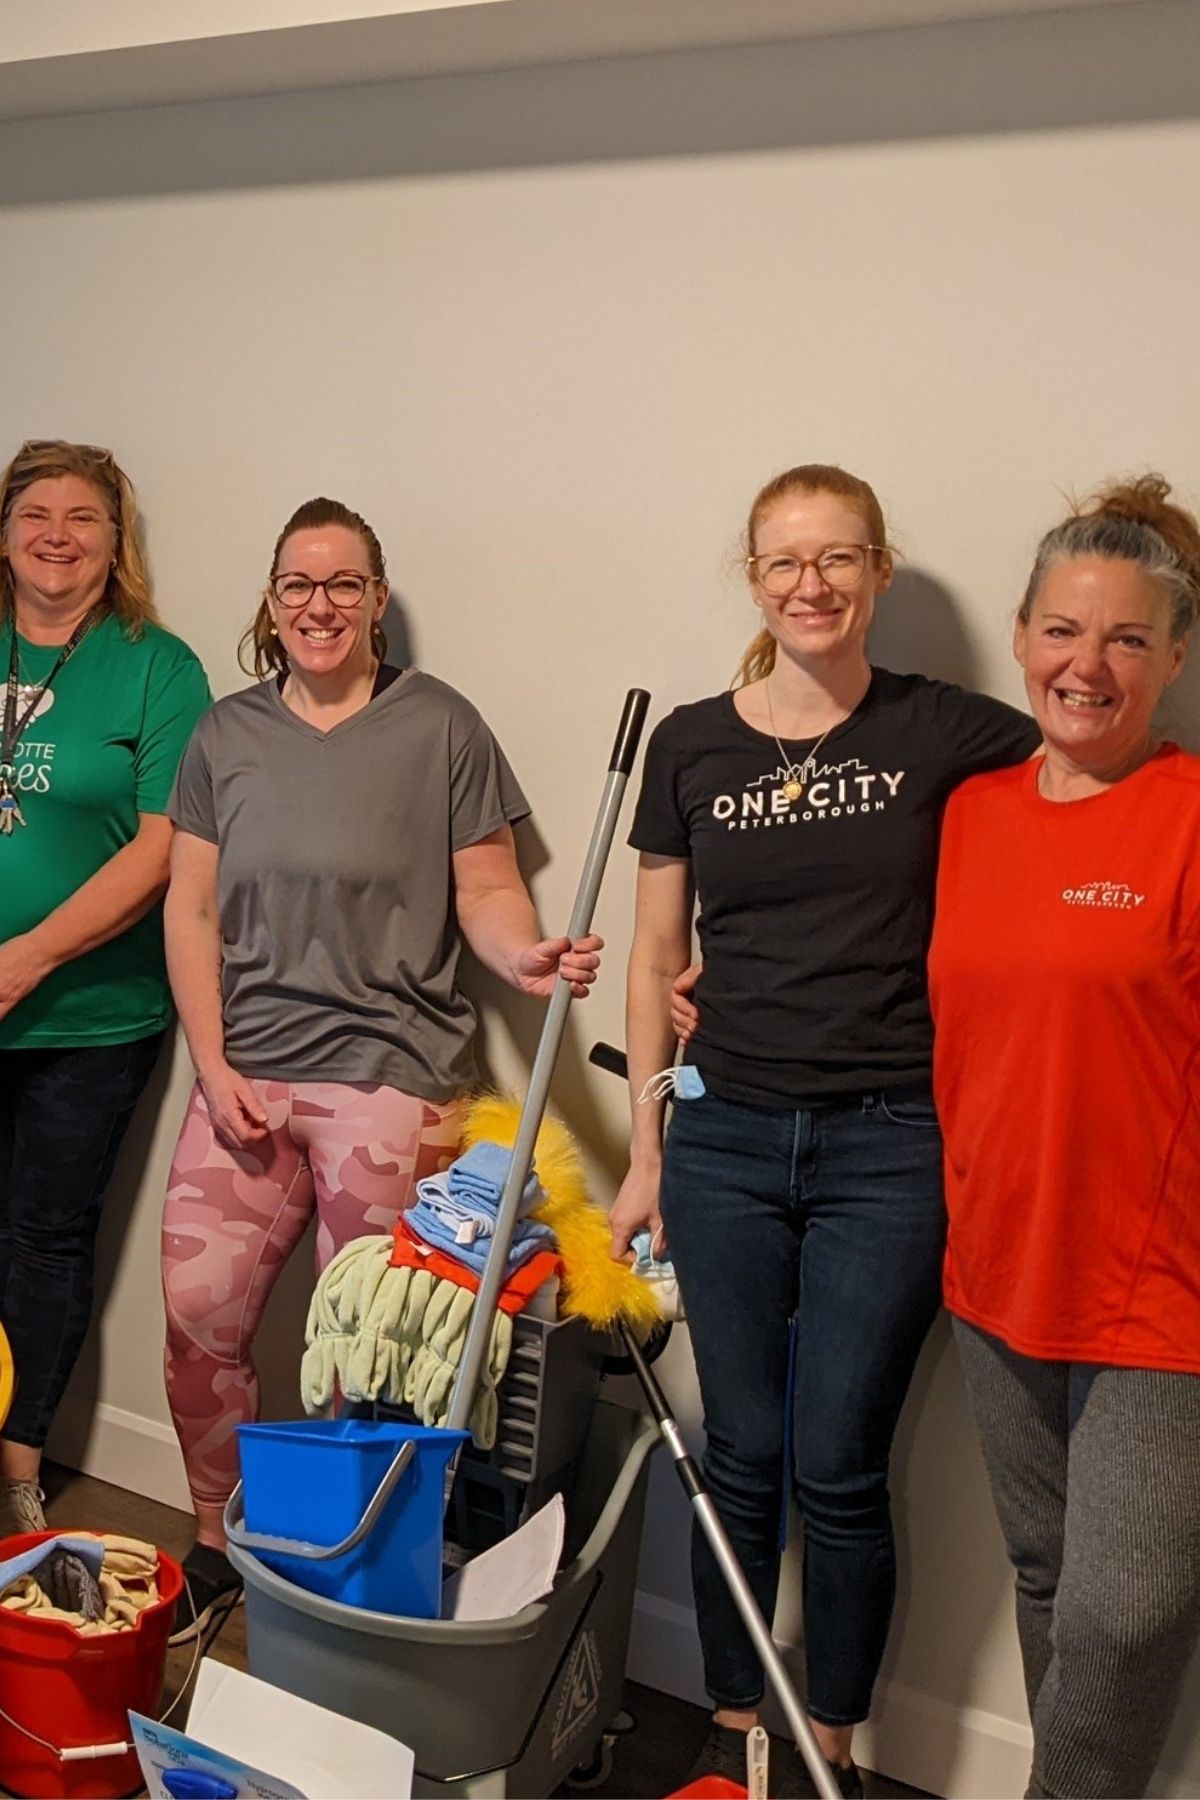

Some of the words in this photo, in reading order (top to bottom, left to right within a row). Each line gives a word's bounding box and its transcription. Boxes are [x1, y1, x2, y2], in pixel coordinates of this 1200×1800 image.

[712, 789, 791, 820] ONE
[808, 771, 905, 807] CITY
[728, 800, 885, 830] PETERBOROUGH
[1062, 889, 1097, 901] ONE
[1101, 891, 1145, 906] CITY
